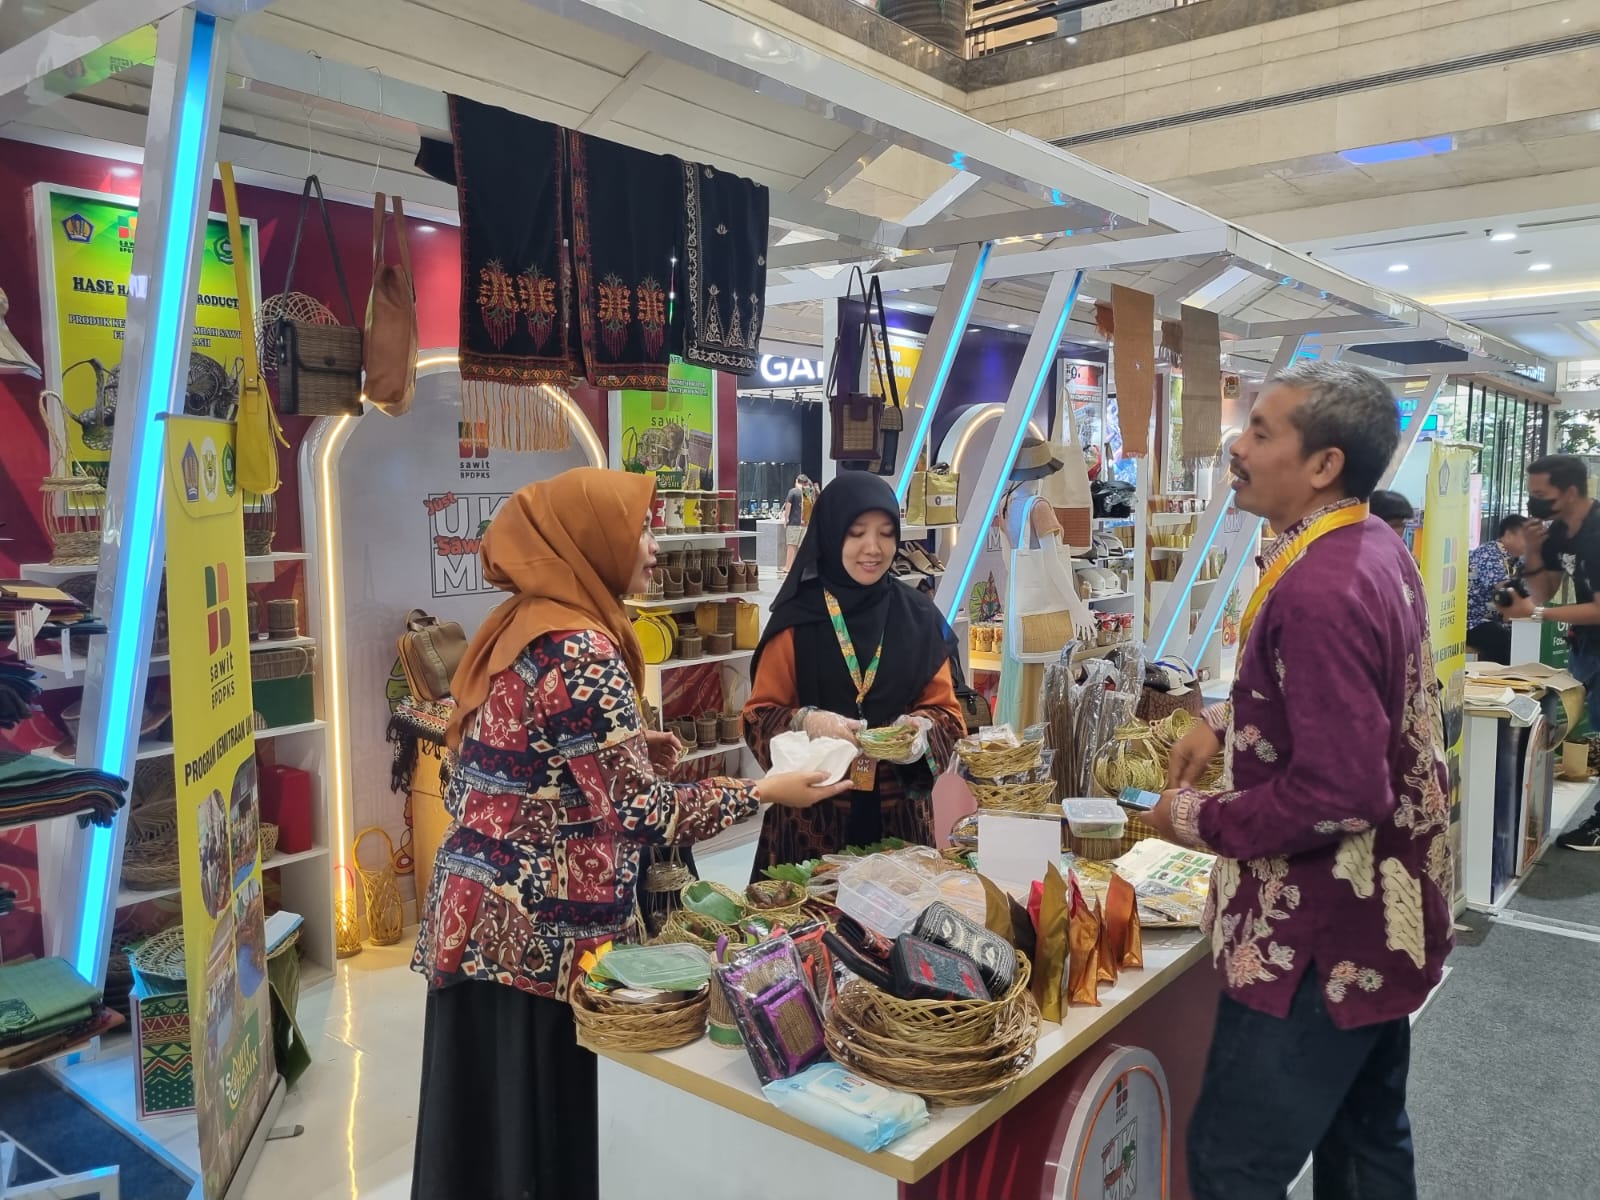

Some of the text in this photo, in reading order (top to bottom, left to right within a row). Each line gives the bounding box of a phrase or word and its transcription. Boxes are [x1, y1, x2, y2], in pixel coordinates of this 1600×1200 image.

[73, 276, 129, 297] HASE H
[197, 294, 240, 310] RODUCT
[68, 313, 127, 328] PRODUK KE
[760, 354, 824, 383] GA
[459, 459, 490, 469] sawit
[423, 492, 457, 517] Just
[210, 651, 234, 682] sawit
[211, 680, 235, 710] BPDPKS
[184, 744, 217, 787] PROGRAM
[216, 719, 246, 761] KEMITRAAN
